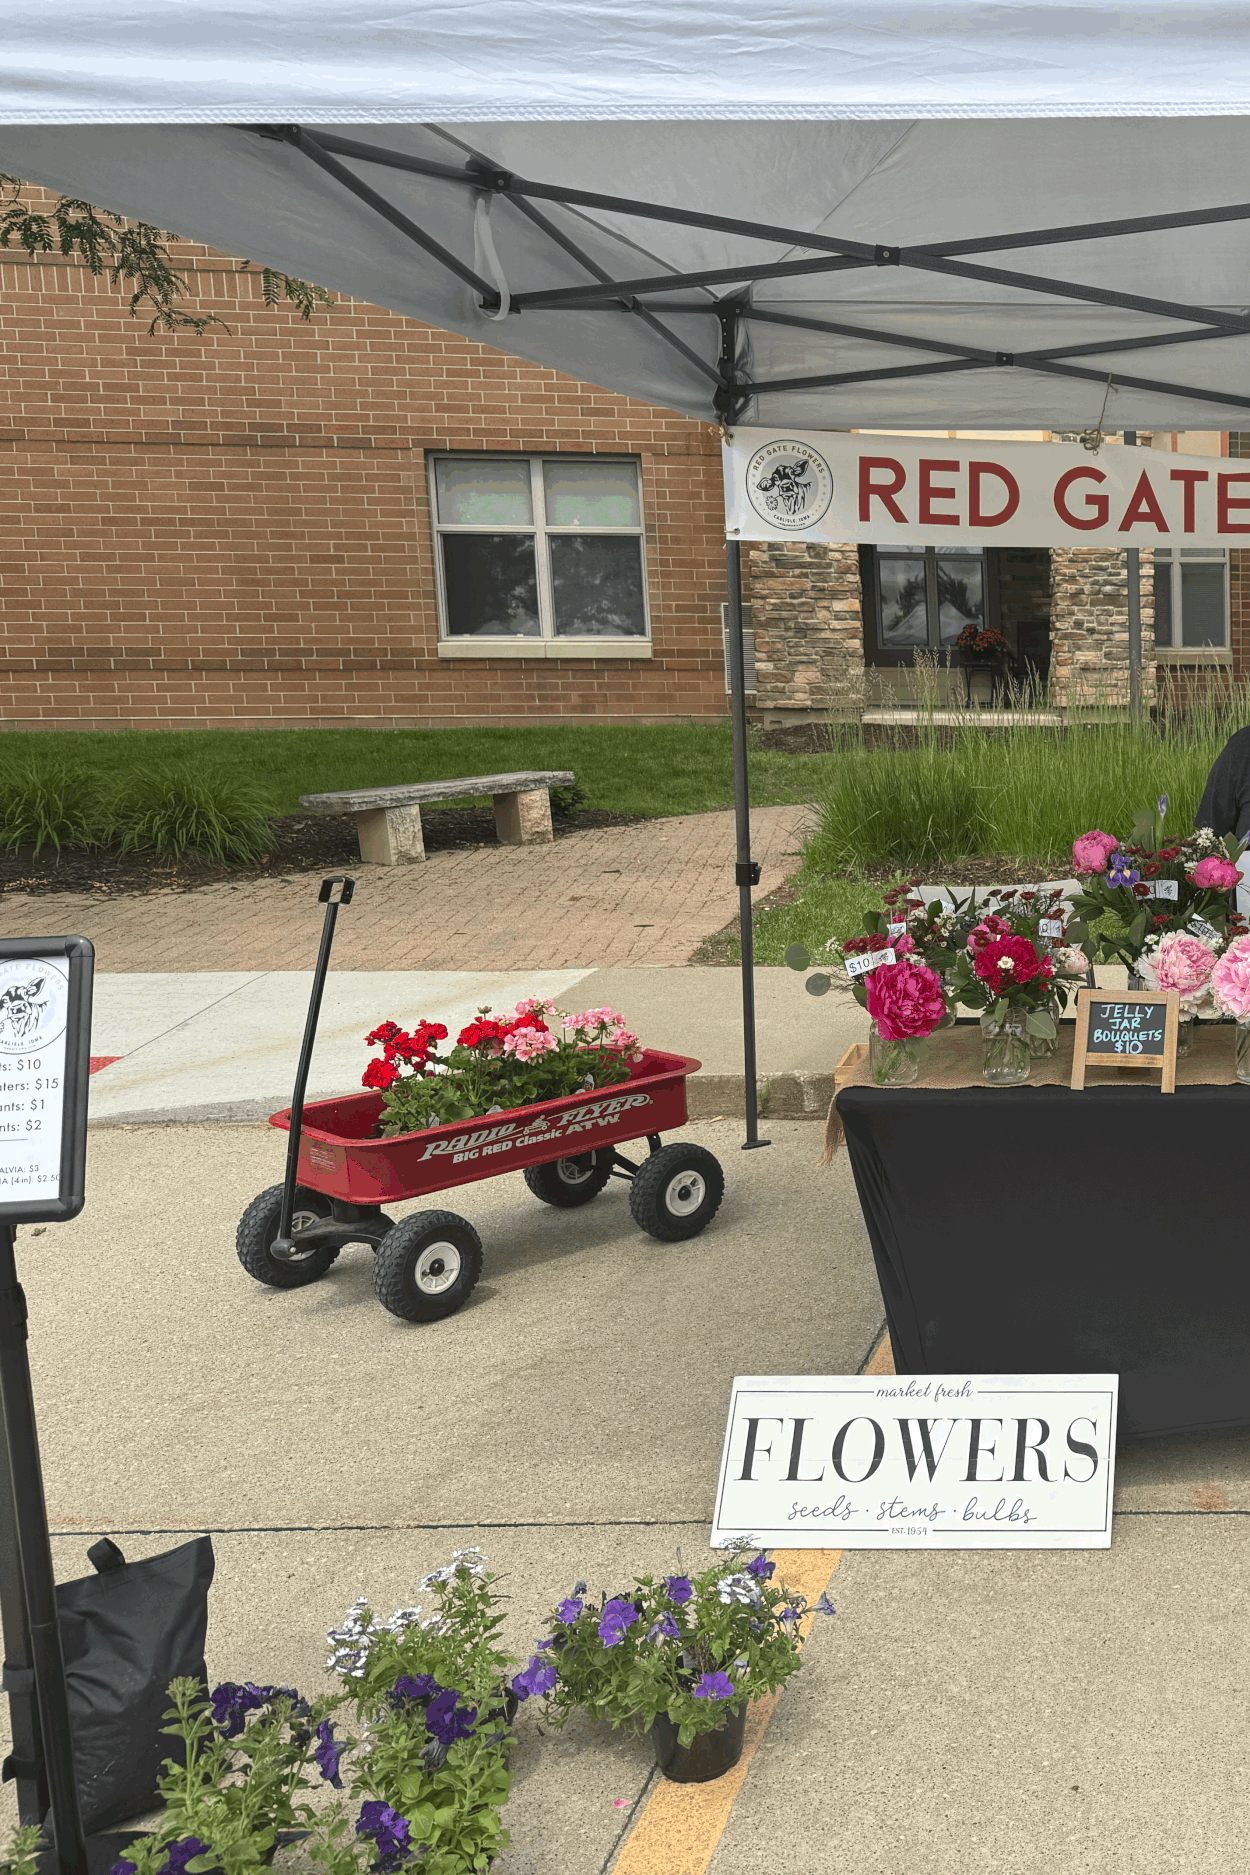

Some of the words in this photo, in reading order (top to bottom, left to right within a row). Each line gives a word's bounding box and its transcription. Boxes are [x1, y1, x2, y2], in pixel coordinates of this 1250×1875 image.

[753, 455, 765, 471] RED
[766, 445, 788, 456] GATE
[792, 446, 825, 474] FLOWERS
[858, 456, 1020, 527] RED
[849, 958, 870, 974] $10
[1100, 1004, 1154, 1018] JELLY
[1108, 1018, 1140, 1030] JAR
[1093, 1028, 1162, 1042] BOUQUETS
[1114, 1039, 1143, 1054] $10
[16, 1058, 42, 1072] $10
[34, 1078, 59, 1090] $15
[30, 1098, 44, 1111] $1
[26, 1118, 42, 1132] $2
[417, 1122, 518, 1162] RADIO
[557, 1094, 650, 1126] FLYER
[452, 1150, 479, 1164] BIG
[482, 1141, 512, 1156] RED
[516, 1128, 562, 1148] Classic
[565, 1113, 620, 1135] ATW
[28, 1164, 40, 1172] $3
[876, 1380, 932, 1398] market
[932, 1380, 974, 1402] fresh
[733, 1416, 1099, 1484] FLOWERS
[788, 1496, 860, 1521] seeds
[876, 1496, 946, 1522] stems
[962, 1498, 1038, 1522] bulbs
[891, 1526, 906, 1534] EST.
[906, 1526, 928, 1536] 1954
